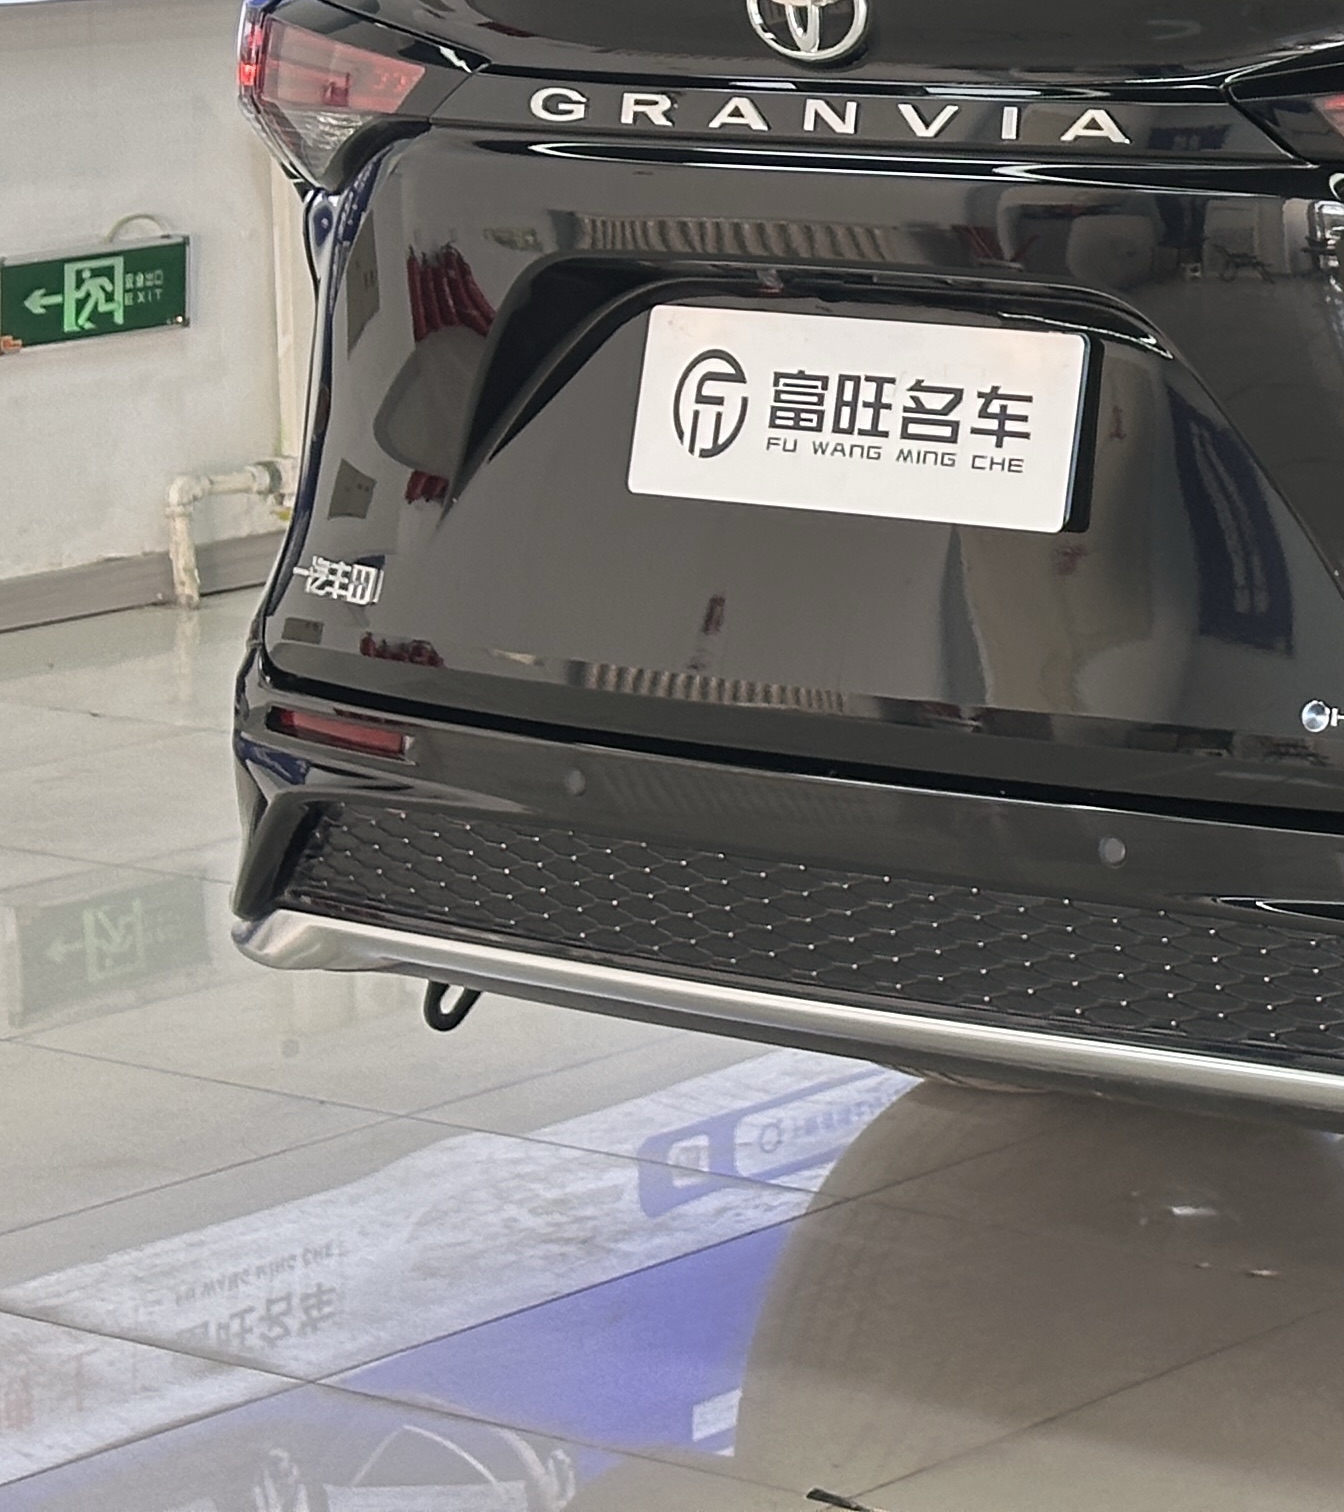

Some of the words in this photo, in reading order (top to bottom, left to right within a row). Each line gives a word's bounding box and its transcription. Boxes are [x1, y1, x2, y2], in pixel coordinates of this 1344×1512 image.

[529, 86, 1132, 146] GRANVIA
[124, 289, 163, 306] EXIT
[767, 369, 1034, 449] 富旺名车
[766, 436, 798, 454] FU
[811, 440, 883, 461] WANG
[895, 448, 957, 468] MING
[971, 453, 1025, 474] CHE
